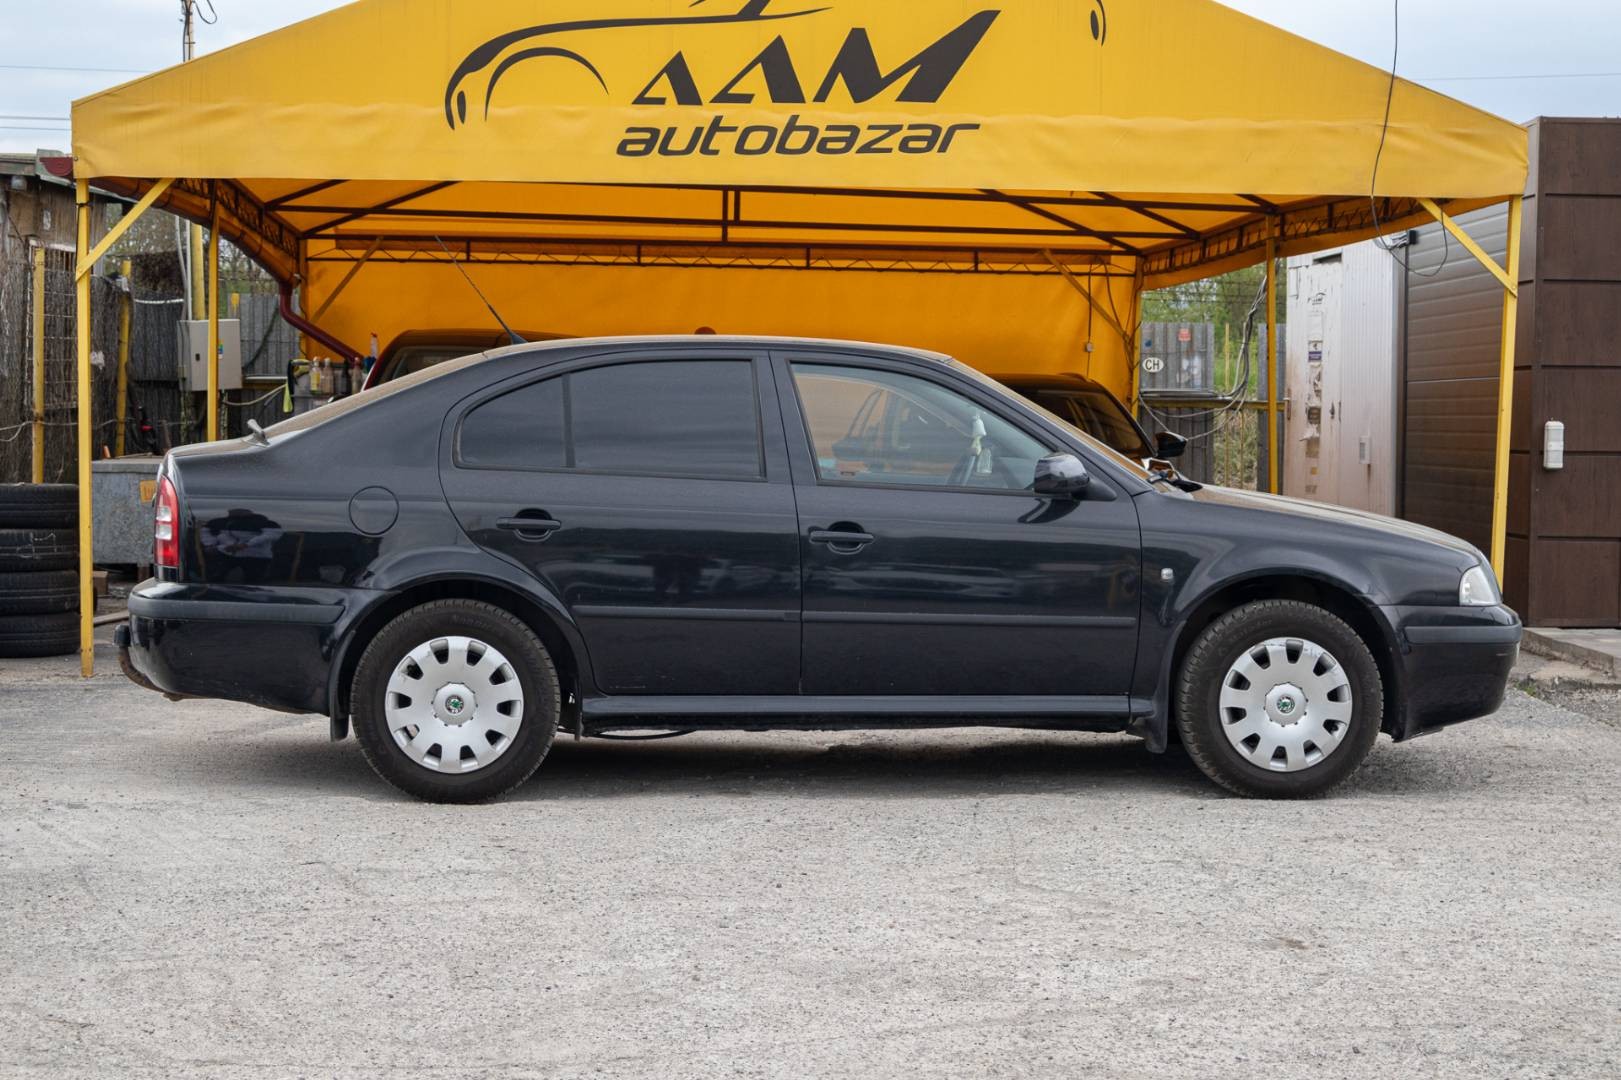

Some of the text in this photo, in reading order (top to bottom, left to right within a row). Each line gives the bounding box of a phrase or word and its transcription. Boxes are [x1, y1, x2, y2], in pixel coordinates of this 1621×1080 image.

[631, 9, 1001, 106] AAM
[616, 114, 980, 157] autobazar
[1145, 359, 1160, 371] CH
